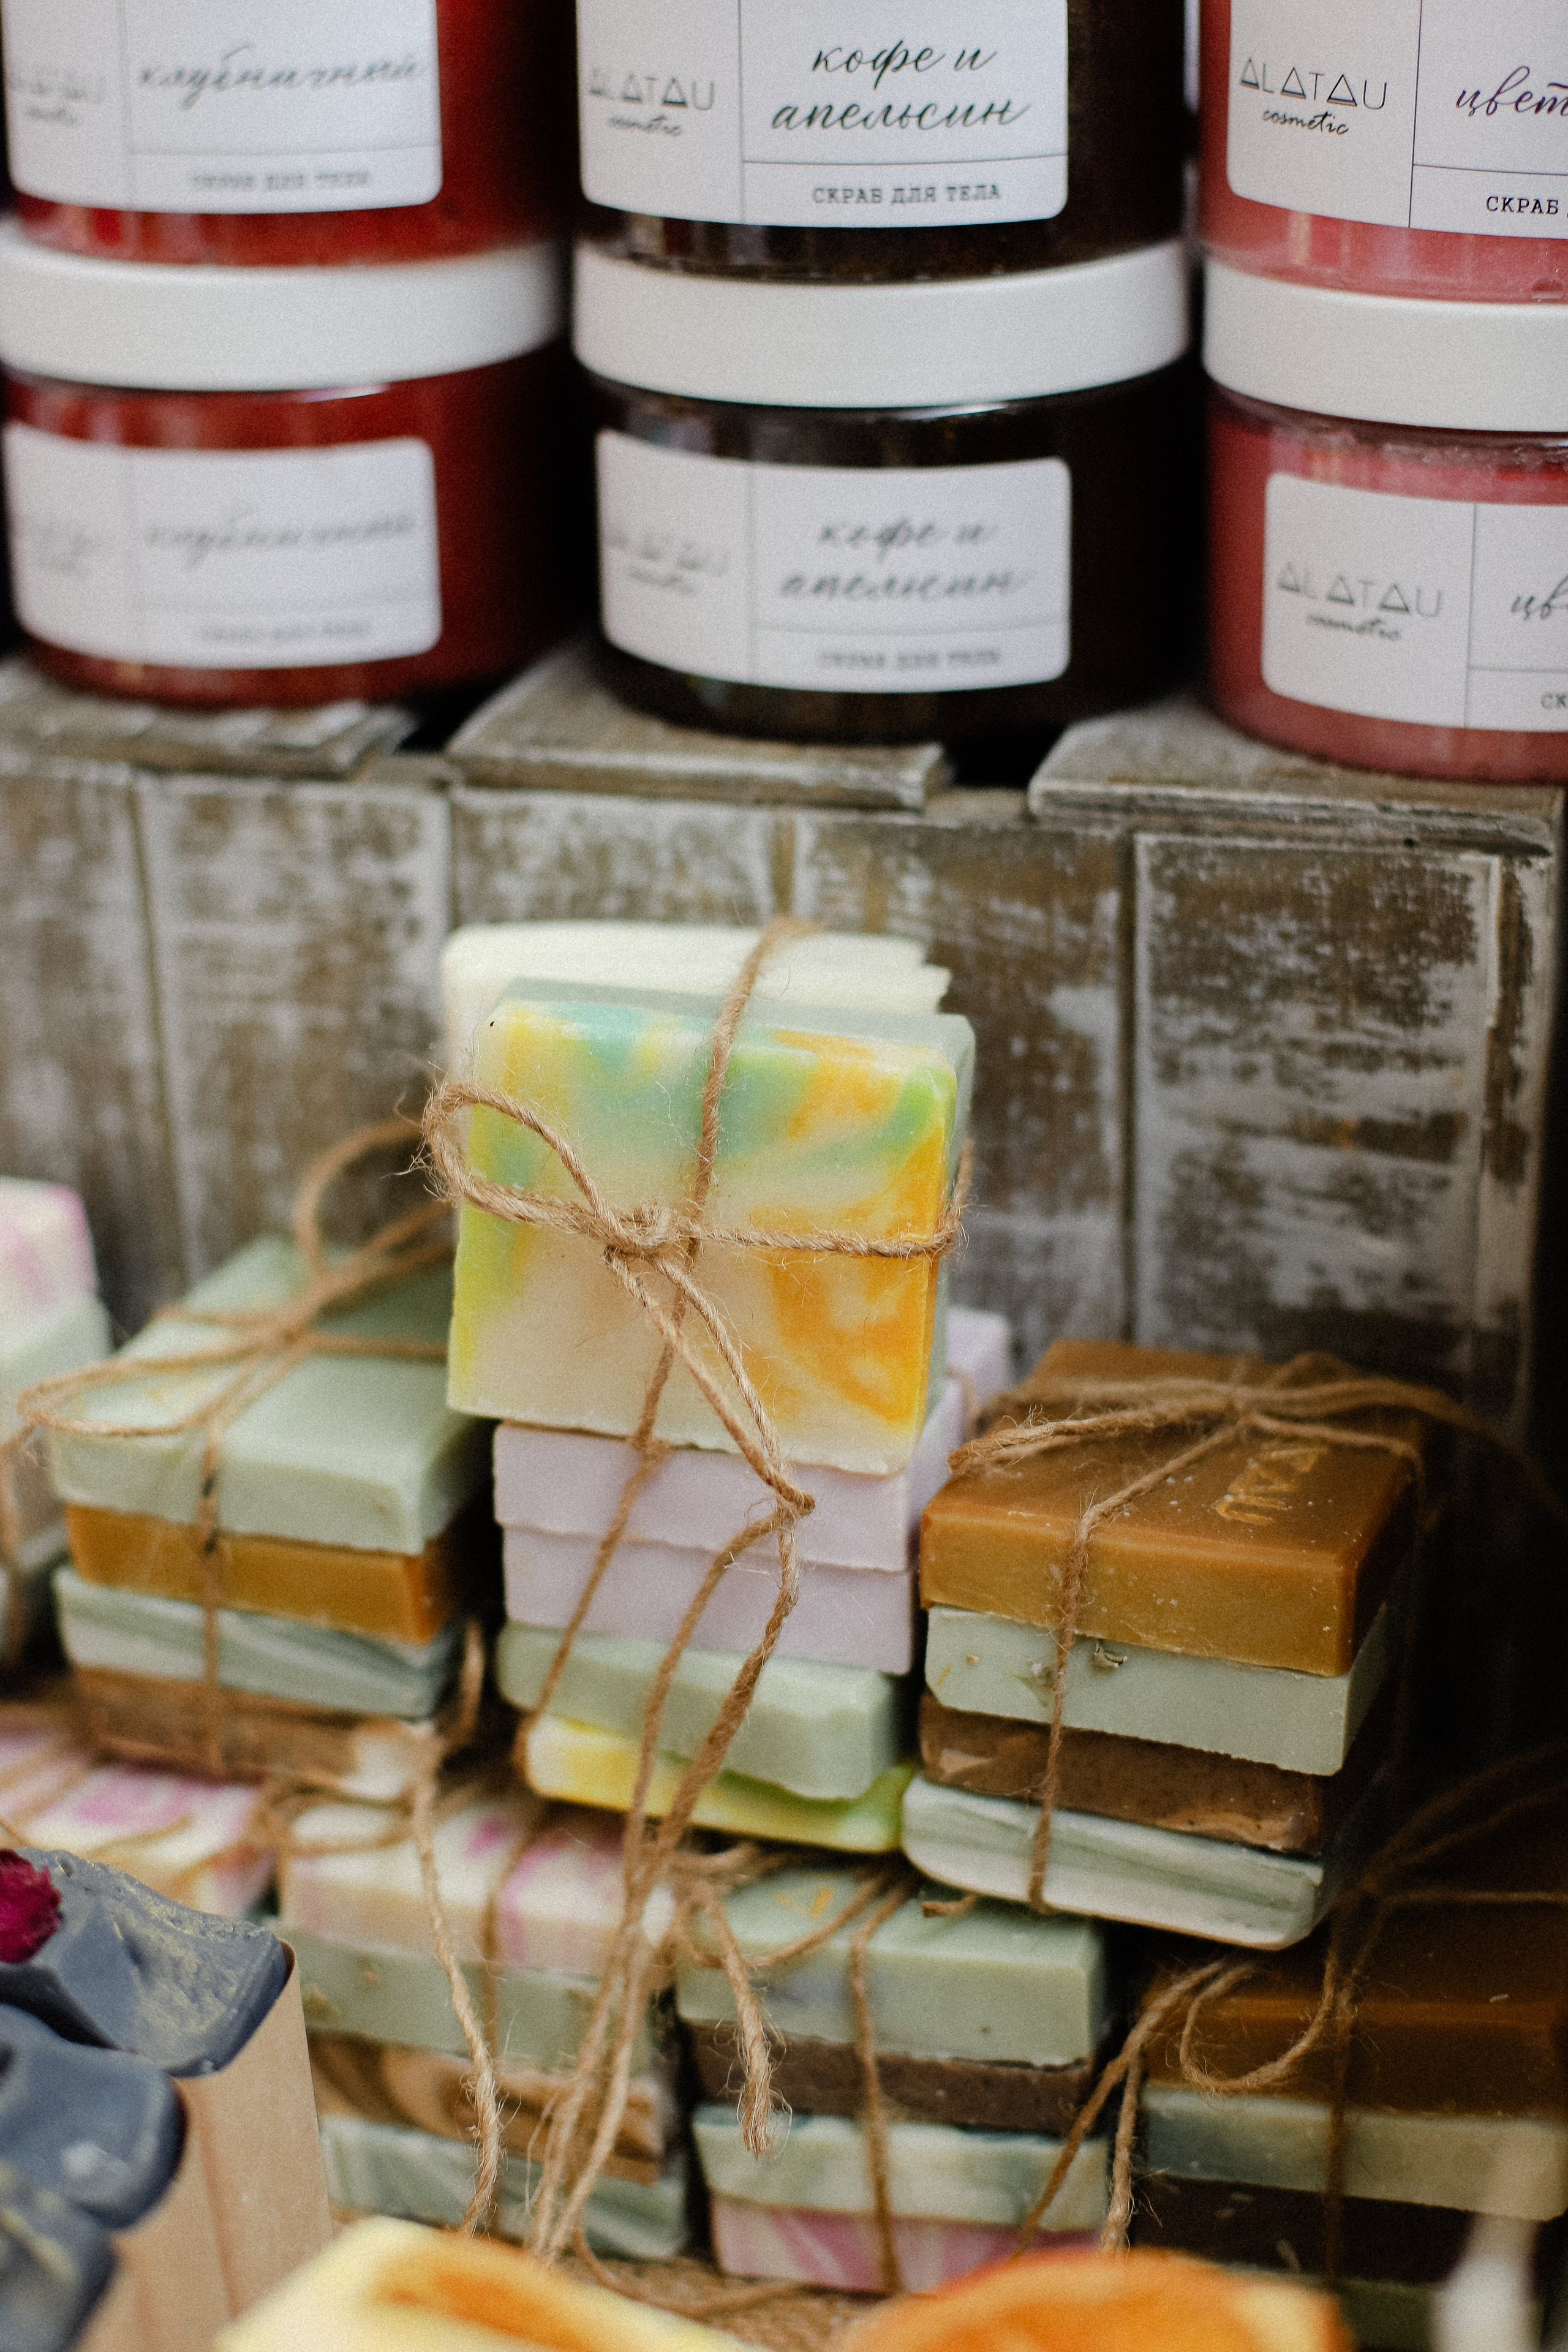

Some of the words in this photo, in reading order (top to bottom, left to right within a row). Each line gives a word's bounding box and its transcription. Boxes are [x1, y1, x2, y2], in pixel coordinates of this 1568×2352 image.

[813, 39, 946, 90] кофе
[954, 47, 998, 72] и
[1240, 57, 1387, 110] ALATAU
[771, 99, 1031, 130] апельсин
[1263, 111, 1349, 135] cosmetic
[812, 186, 883, 204] СКРАБ
[892, 185, 937, 204] ДЛЯ
[946, 183, 1002, 203] ТЕЛА
[1485, 195, 1560, 215] СКРАБ
[1278, 561, 1442, 617] ALATAU
